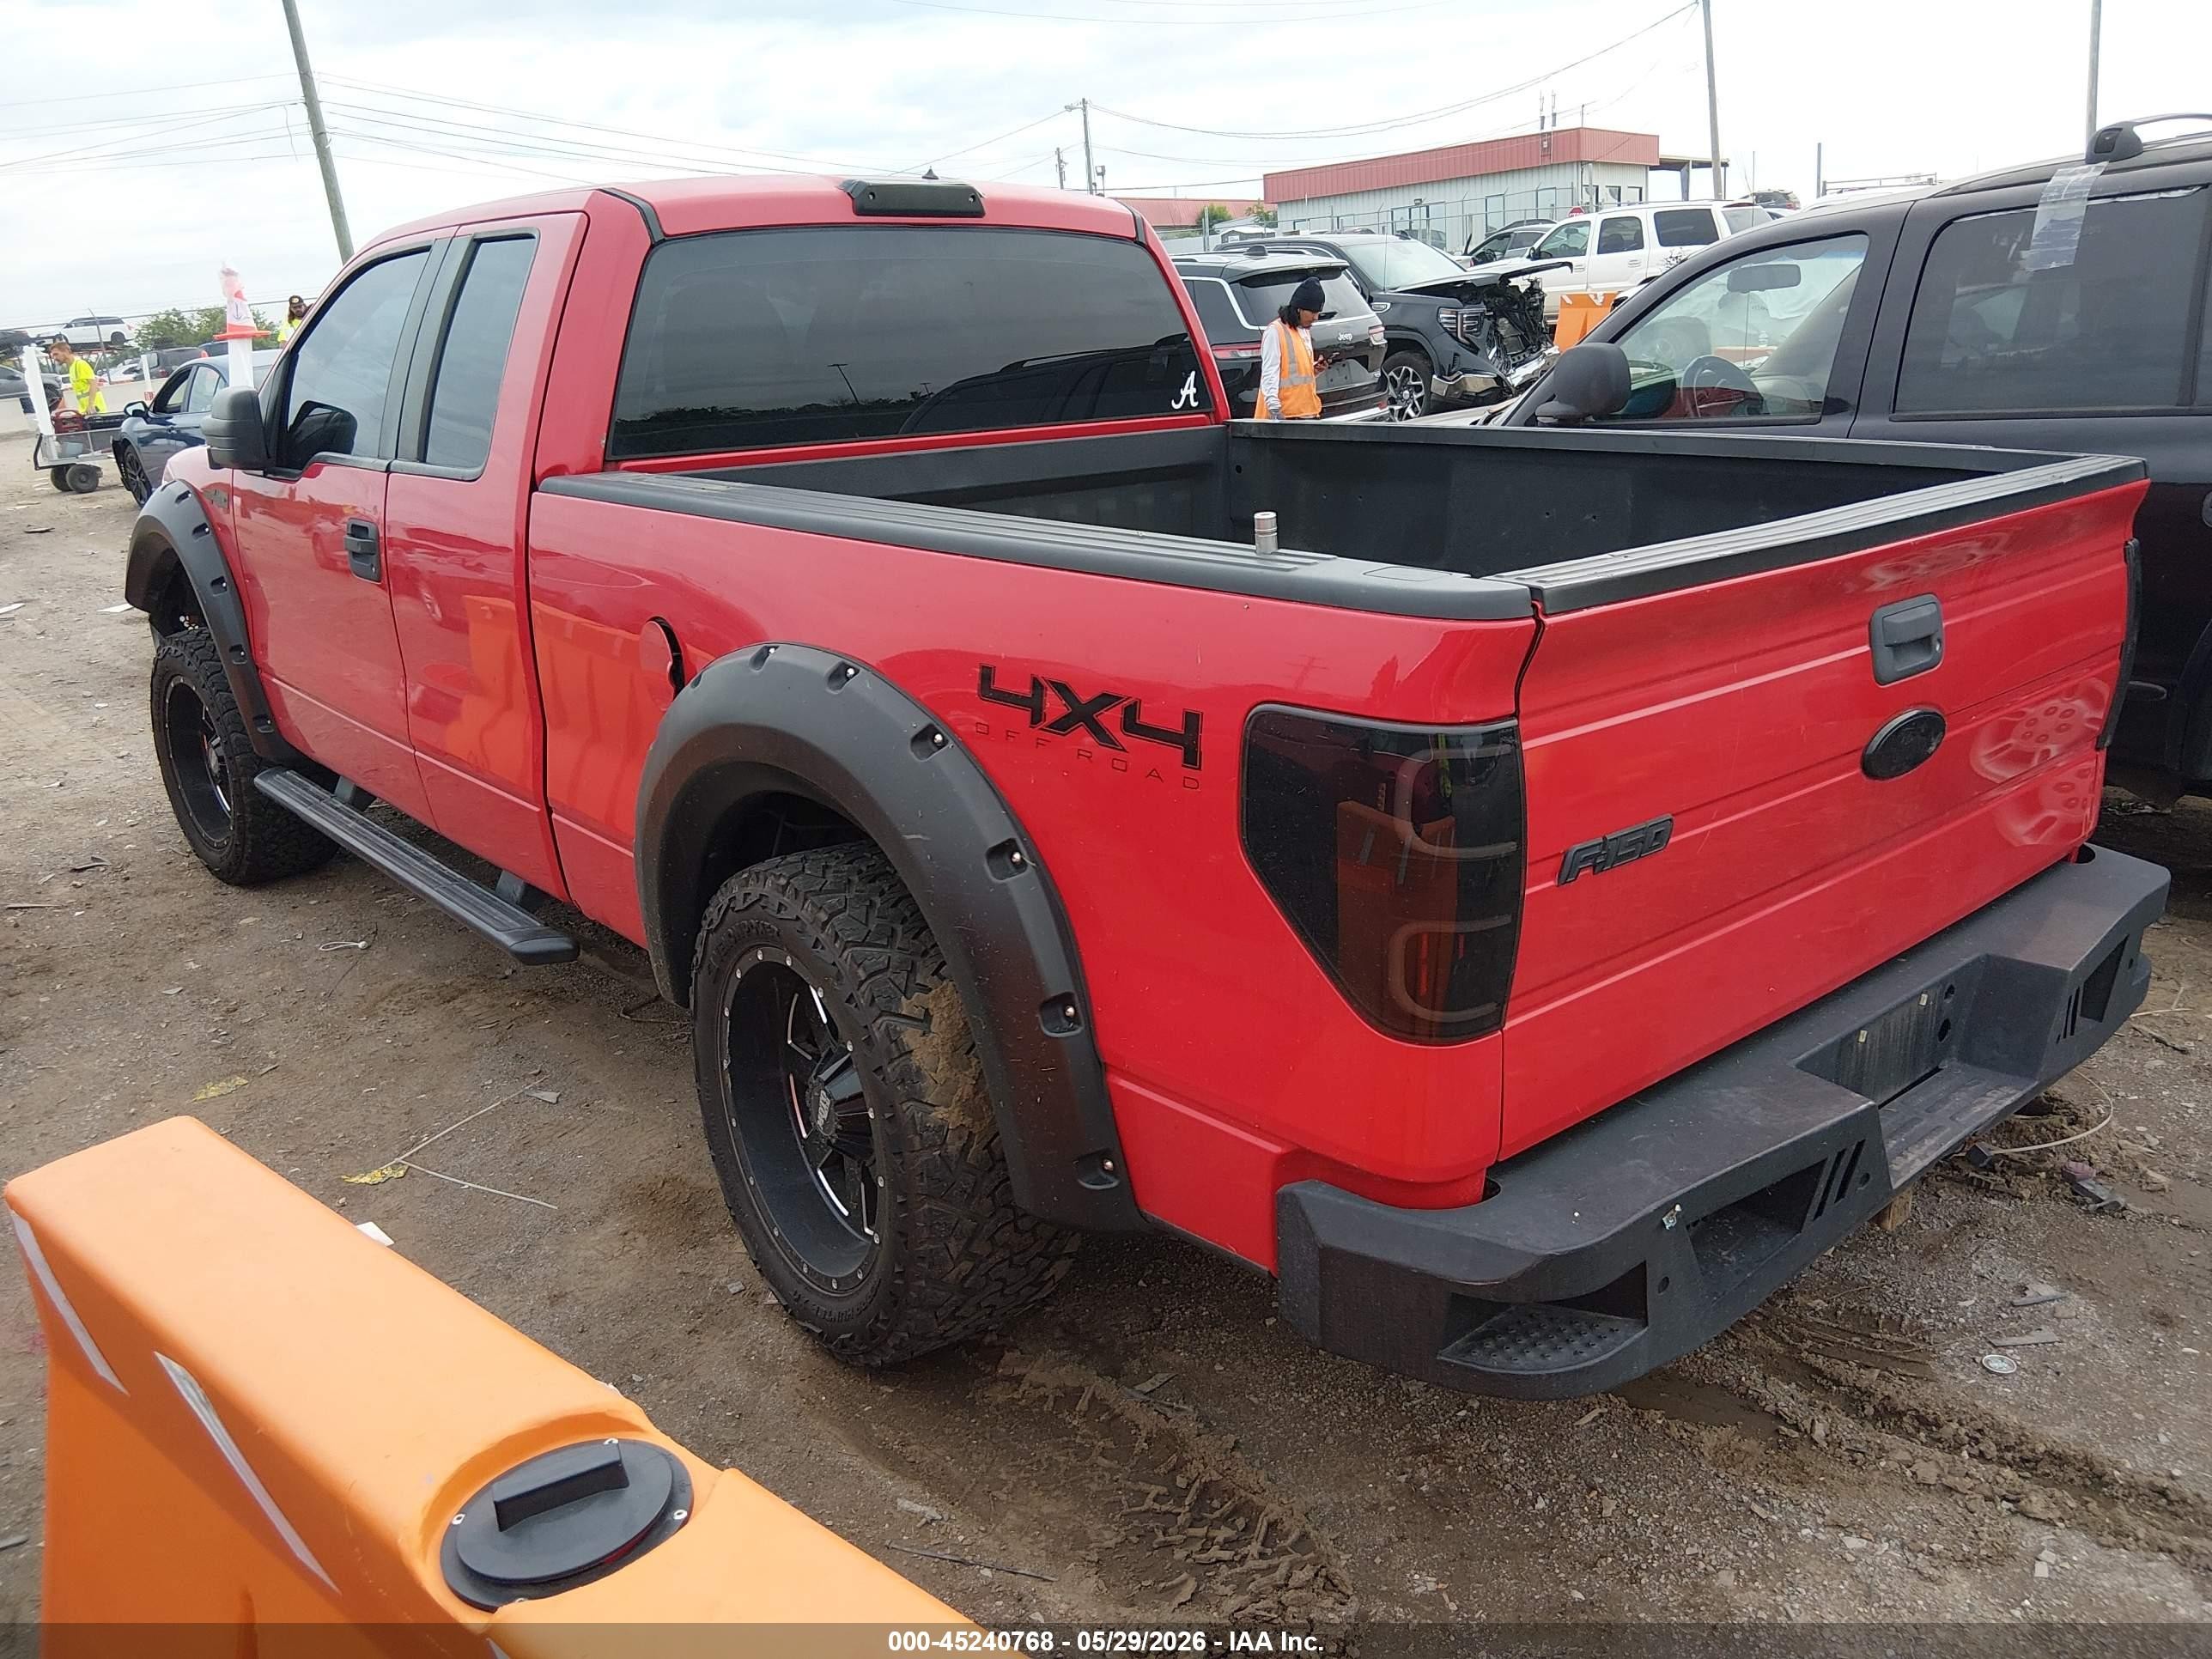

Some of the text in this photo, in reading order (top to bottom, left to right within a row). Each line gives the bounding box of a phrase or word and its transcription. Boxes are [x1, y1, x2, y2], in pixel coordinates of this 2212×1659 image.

[1338, 332, 1352, 342] Jeep
[1171, 370, 1199, 410] A
[1076, 748, 1200, 791] ROAD
[1556, 813, 1674, 886] F-150
